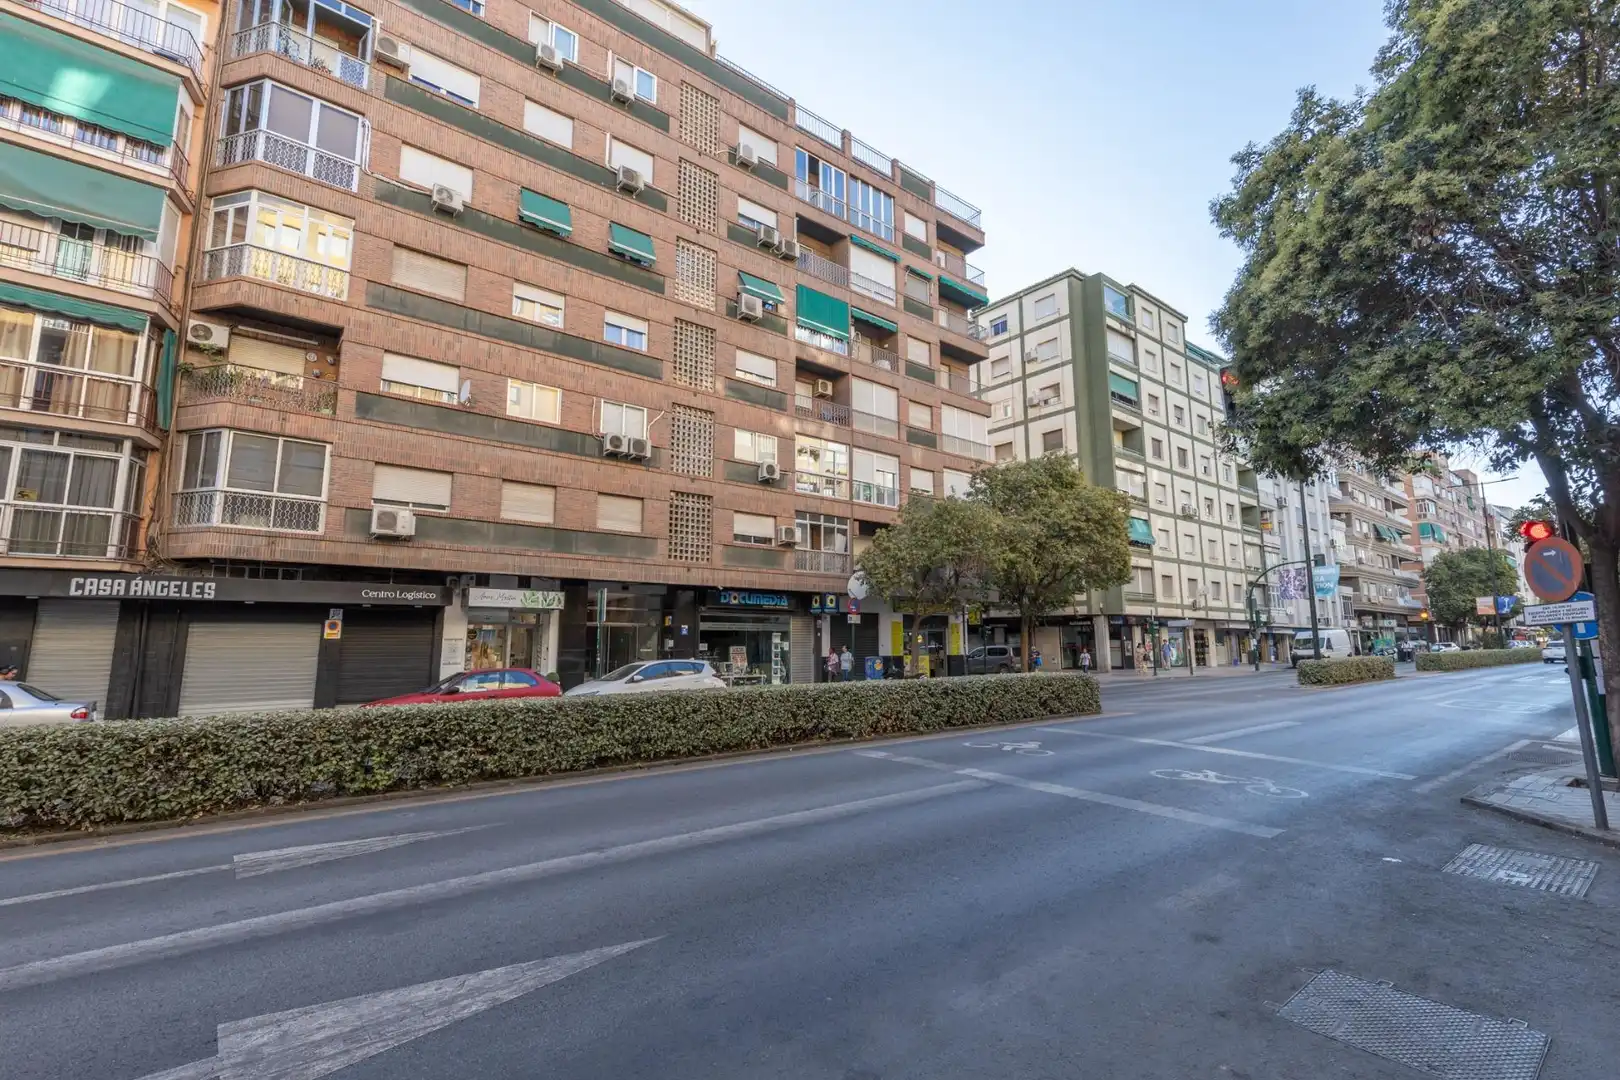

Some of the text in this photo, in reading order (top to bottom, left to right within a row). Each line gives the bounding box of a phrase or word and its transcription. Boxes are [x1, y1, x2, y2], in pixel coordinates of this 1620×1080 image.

[69, 576, 216, 599] CASA ÁNGELES
[361, 589, 437, 600] Centro Logístico
